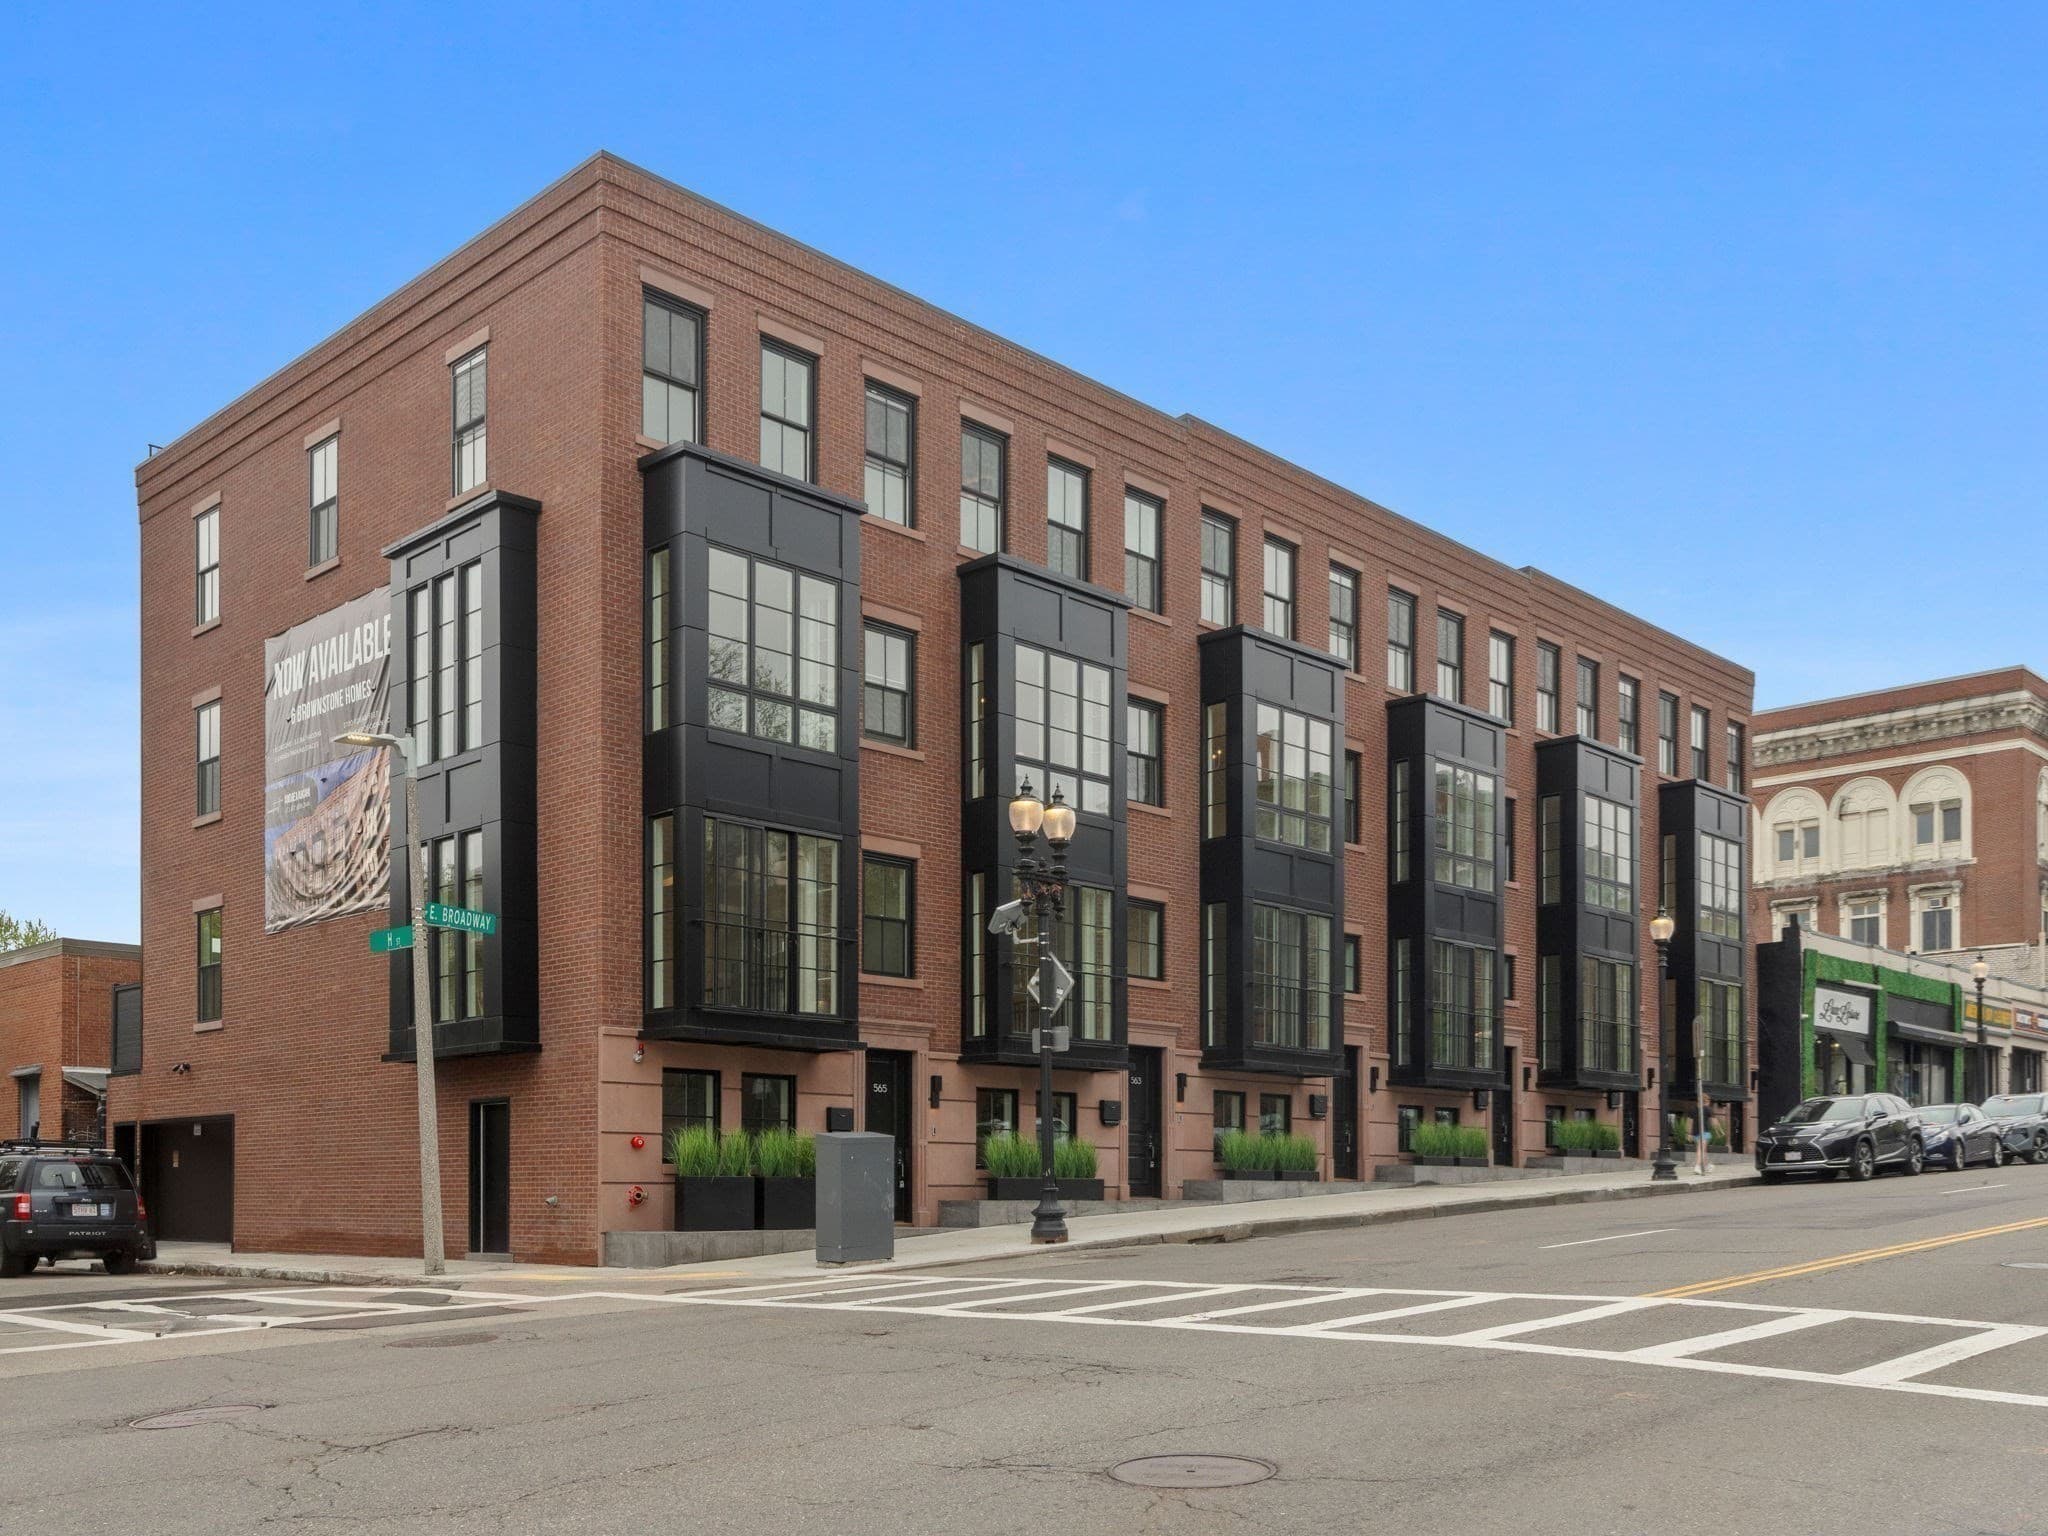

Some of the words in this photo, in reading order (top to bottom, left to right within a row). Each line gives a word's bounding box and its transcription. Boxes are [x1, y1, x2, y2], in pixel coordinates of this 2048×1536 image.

[273, 650, 306, 700] NOW
[309, 614, 391, 687] AVAILABLE
[297, 688, 344, 722] BROWNSTONE
[345, 679, 371, 705] HOMES
[429, 905, 438, 920] E.
[442, 907, 491, 930] BROADWAY
[387, 932, 393, 947] H
[873, 1083, 888, 1093] 565
